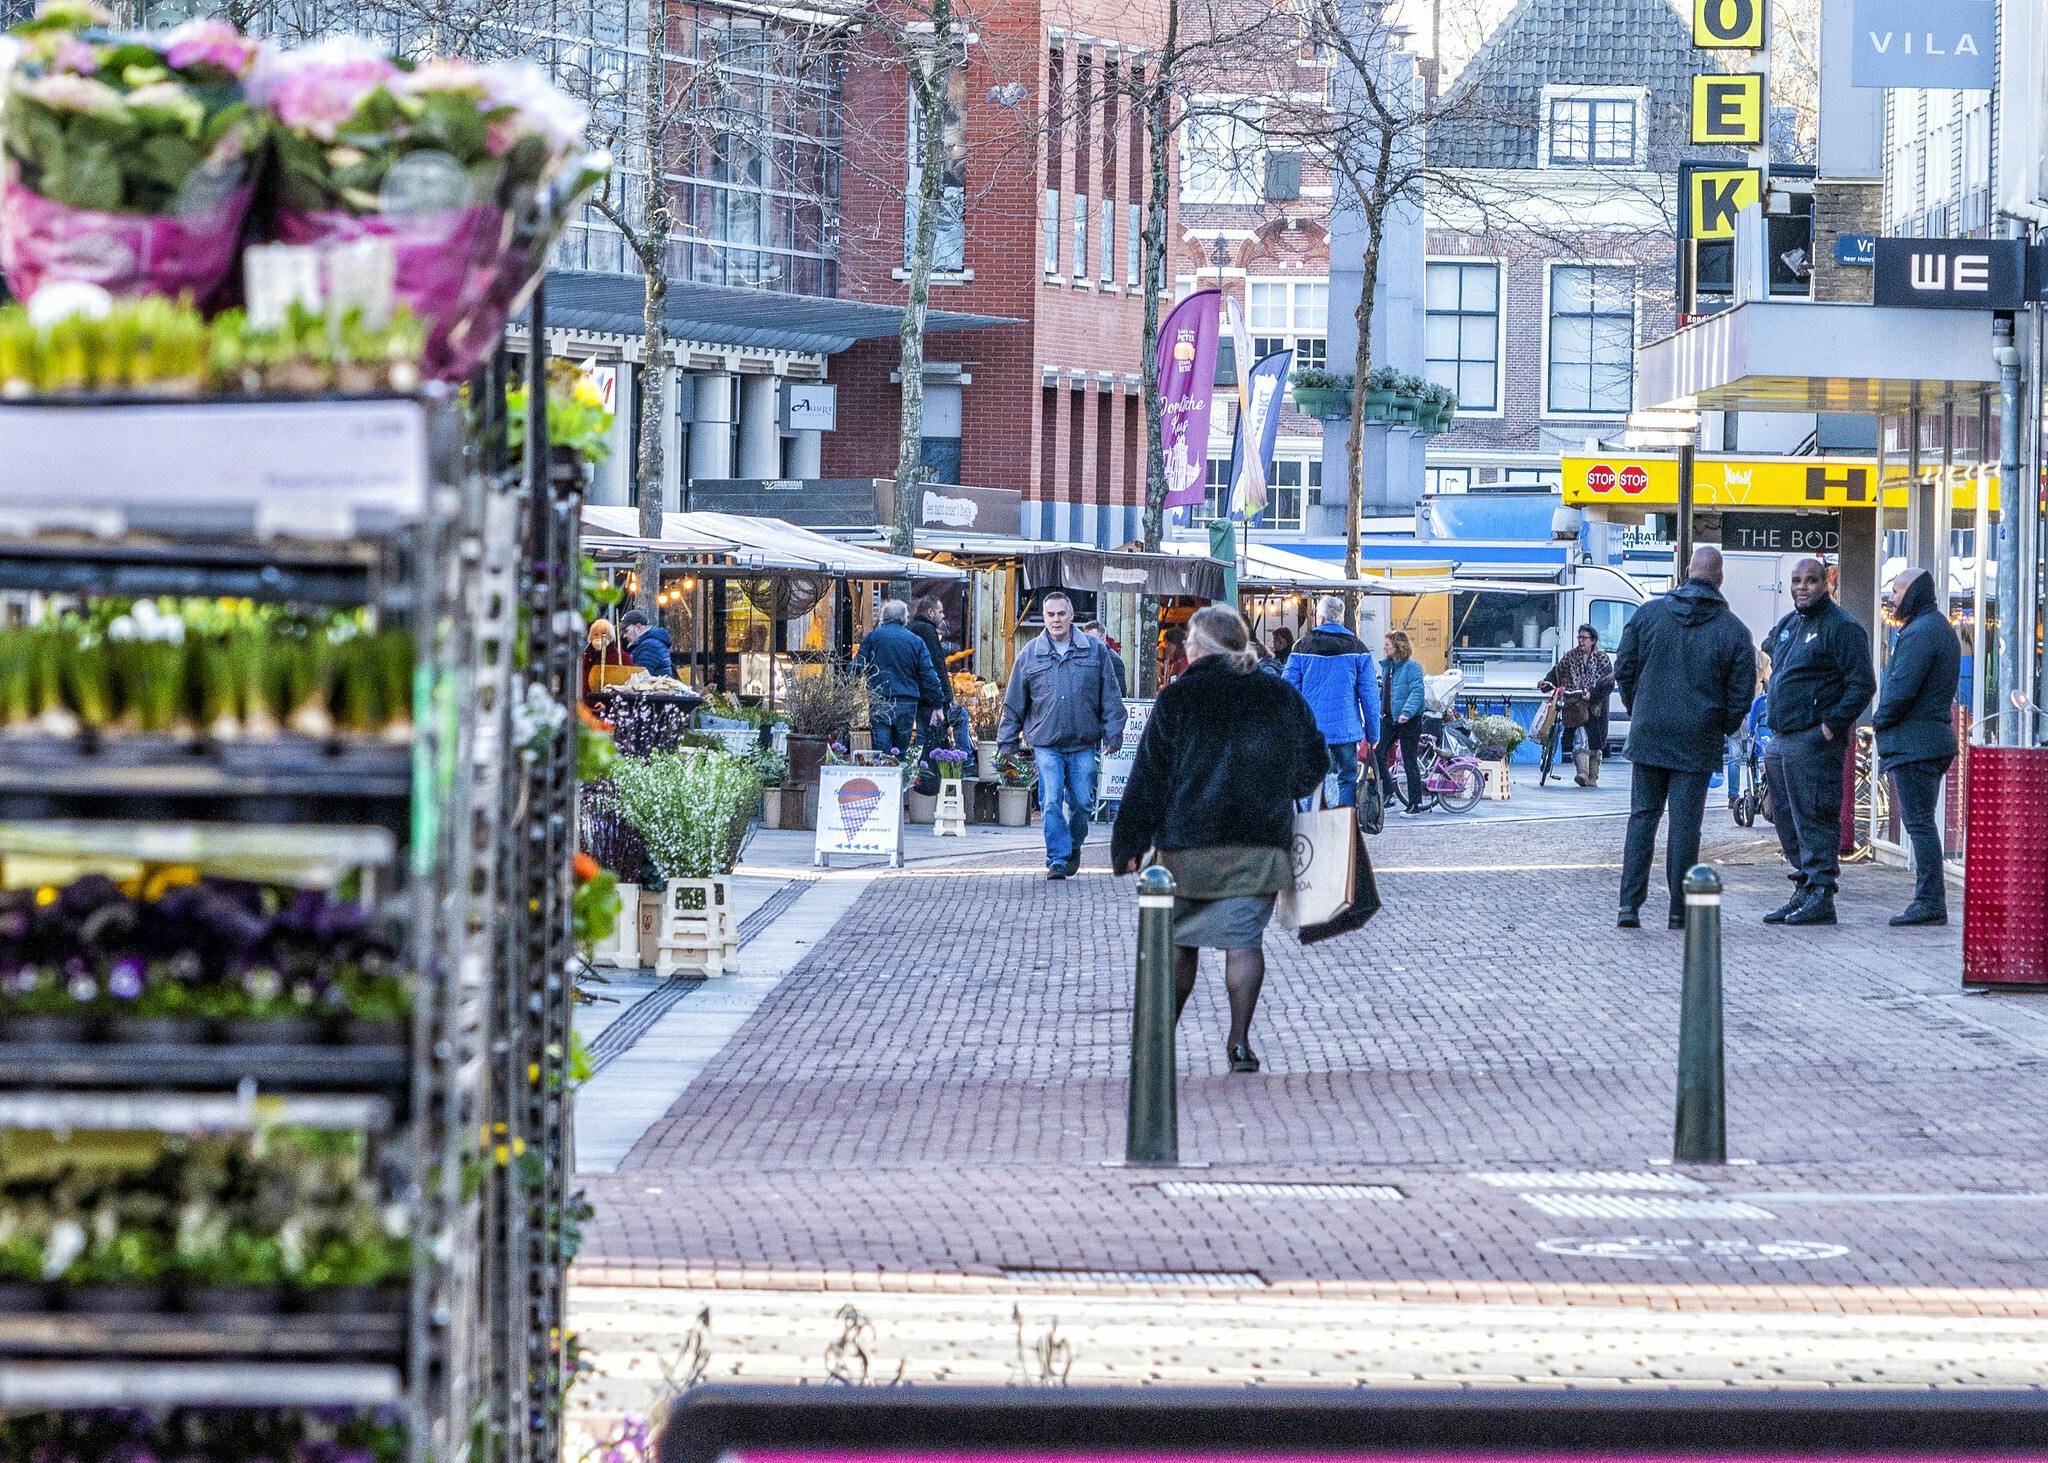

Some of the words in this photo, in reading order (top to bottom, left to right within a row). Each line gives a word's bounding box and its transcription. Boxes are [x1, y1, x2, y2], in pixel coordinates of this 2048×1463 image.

[1869, 31, 1979, 56] VILA
[1857, 239, 1873, 252] Vr
[1911, 254, 1989, 291] WE
[1588, 473, 1616, 485] STOP
[1620, 474, 1648, 486] STOP
[1738, 529, 1780, 547] THE
[1791, 531, 1839, 549] BOD
